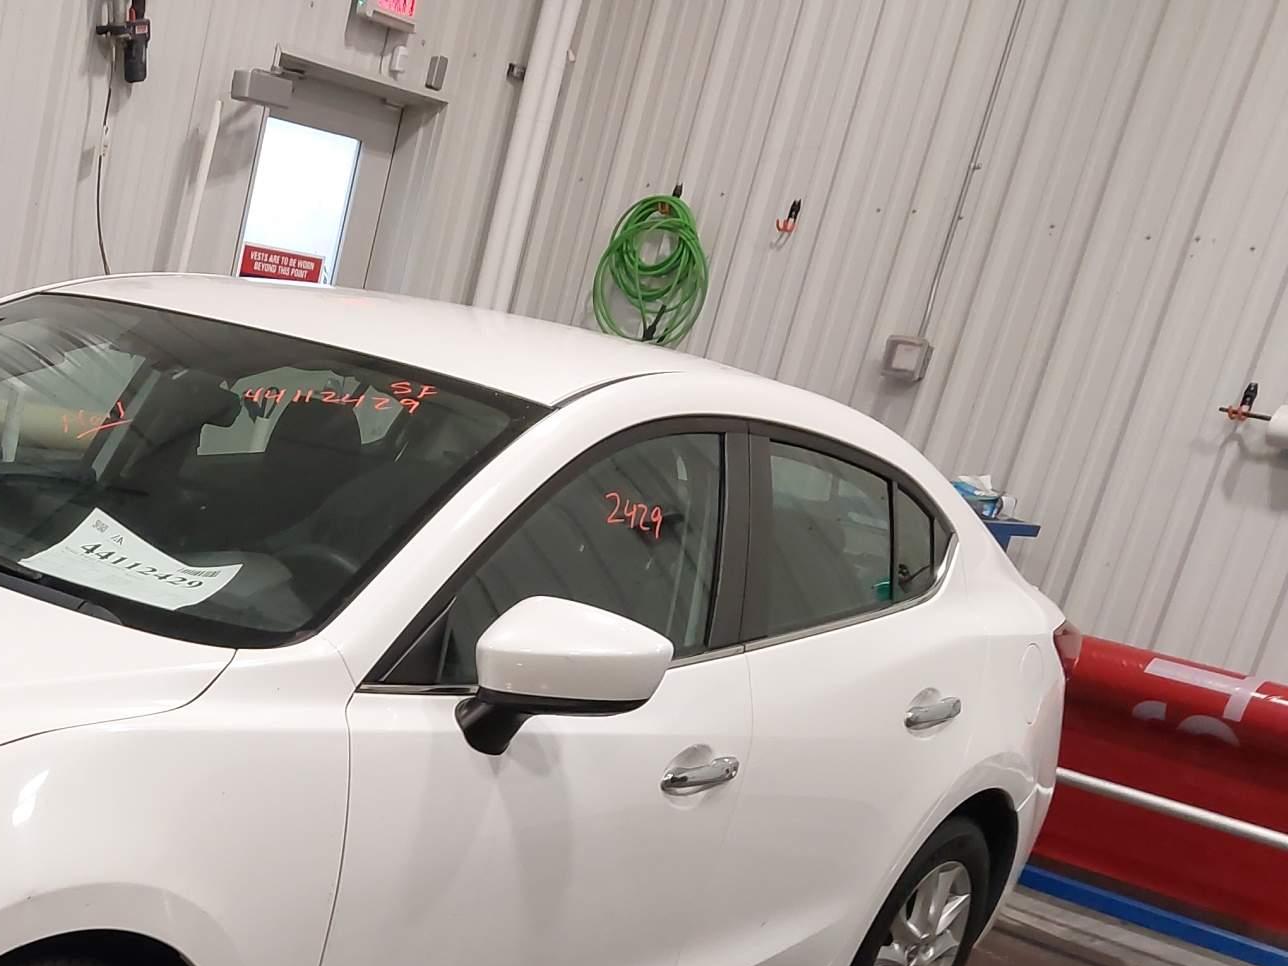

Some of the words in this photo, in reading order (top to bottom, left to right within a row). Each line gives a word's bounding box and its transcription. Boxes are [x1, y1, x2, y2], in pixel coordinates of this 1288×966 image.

[250, 251, 268, 261] VESTS
[269, 254, 280, 264] ARE
[281, 256, 289, 265] TO
[289, 258, 297, 267] BE
[297, 260, 315, 271] WORN
[253, 261, 277, 272] BEYOND
[278, 265, 290, 275] THIS
[291, 268, 308, 279] POINT
[244, 387, 420, 414] 44112429
[605, 492, 663, 539] 2429
[80, 543, 203, 589] 44112429
